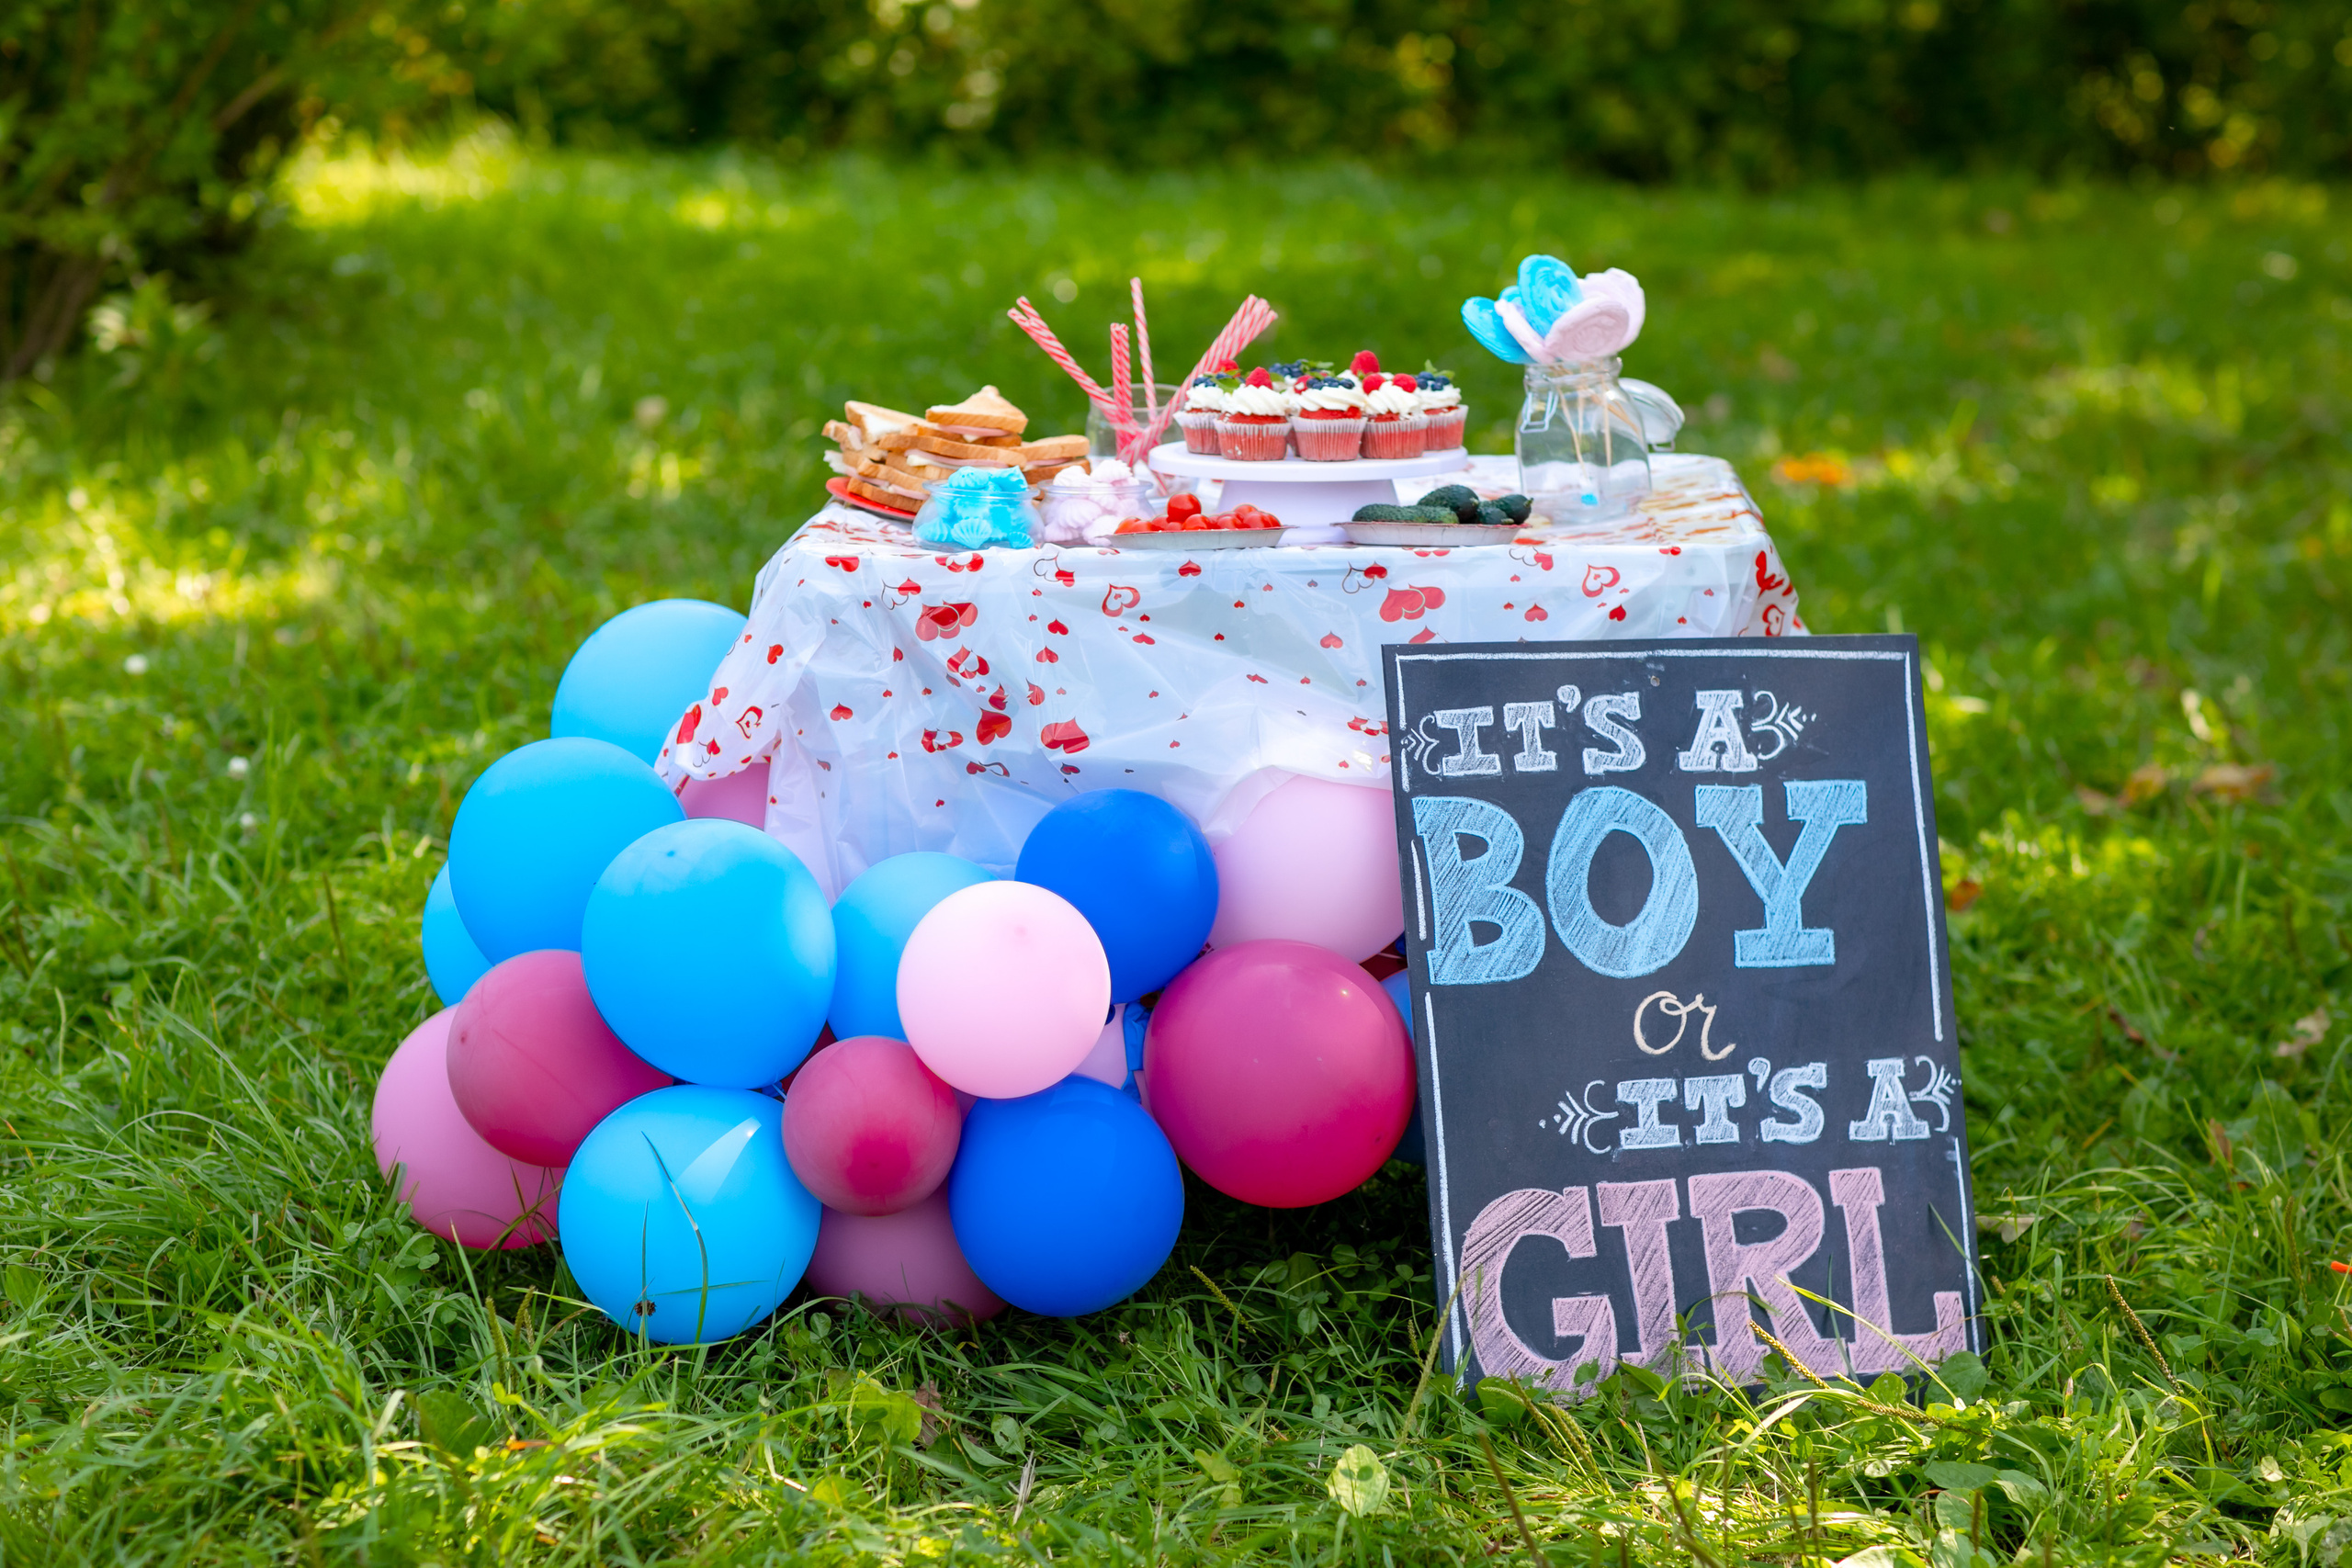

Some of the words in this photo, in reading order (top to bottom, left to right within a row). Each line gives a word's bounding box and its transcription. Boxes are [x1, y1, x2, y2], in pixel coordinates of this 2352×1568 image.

[1433, 684, 1647, 776] IT'S
[1679, 689, 1758, 773] A
[1411, 779, 1868, 987] BOY
[1615, 1056, 1827, 1150] IT'S
[1849, 1057, 1930, 1143] A
[1459, 1166, 1967, 1404] GIRL
